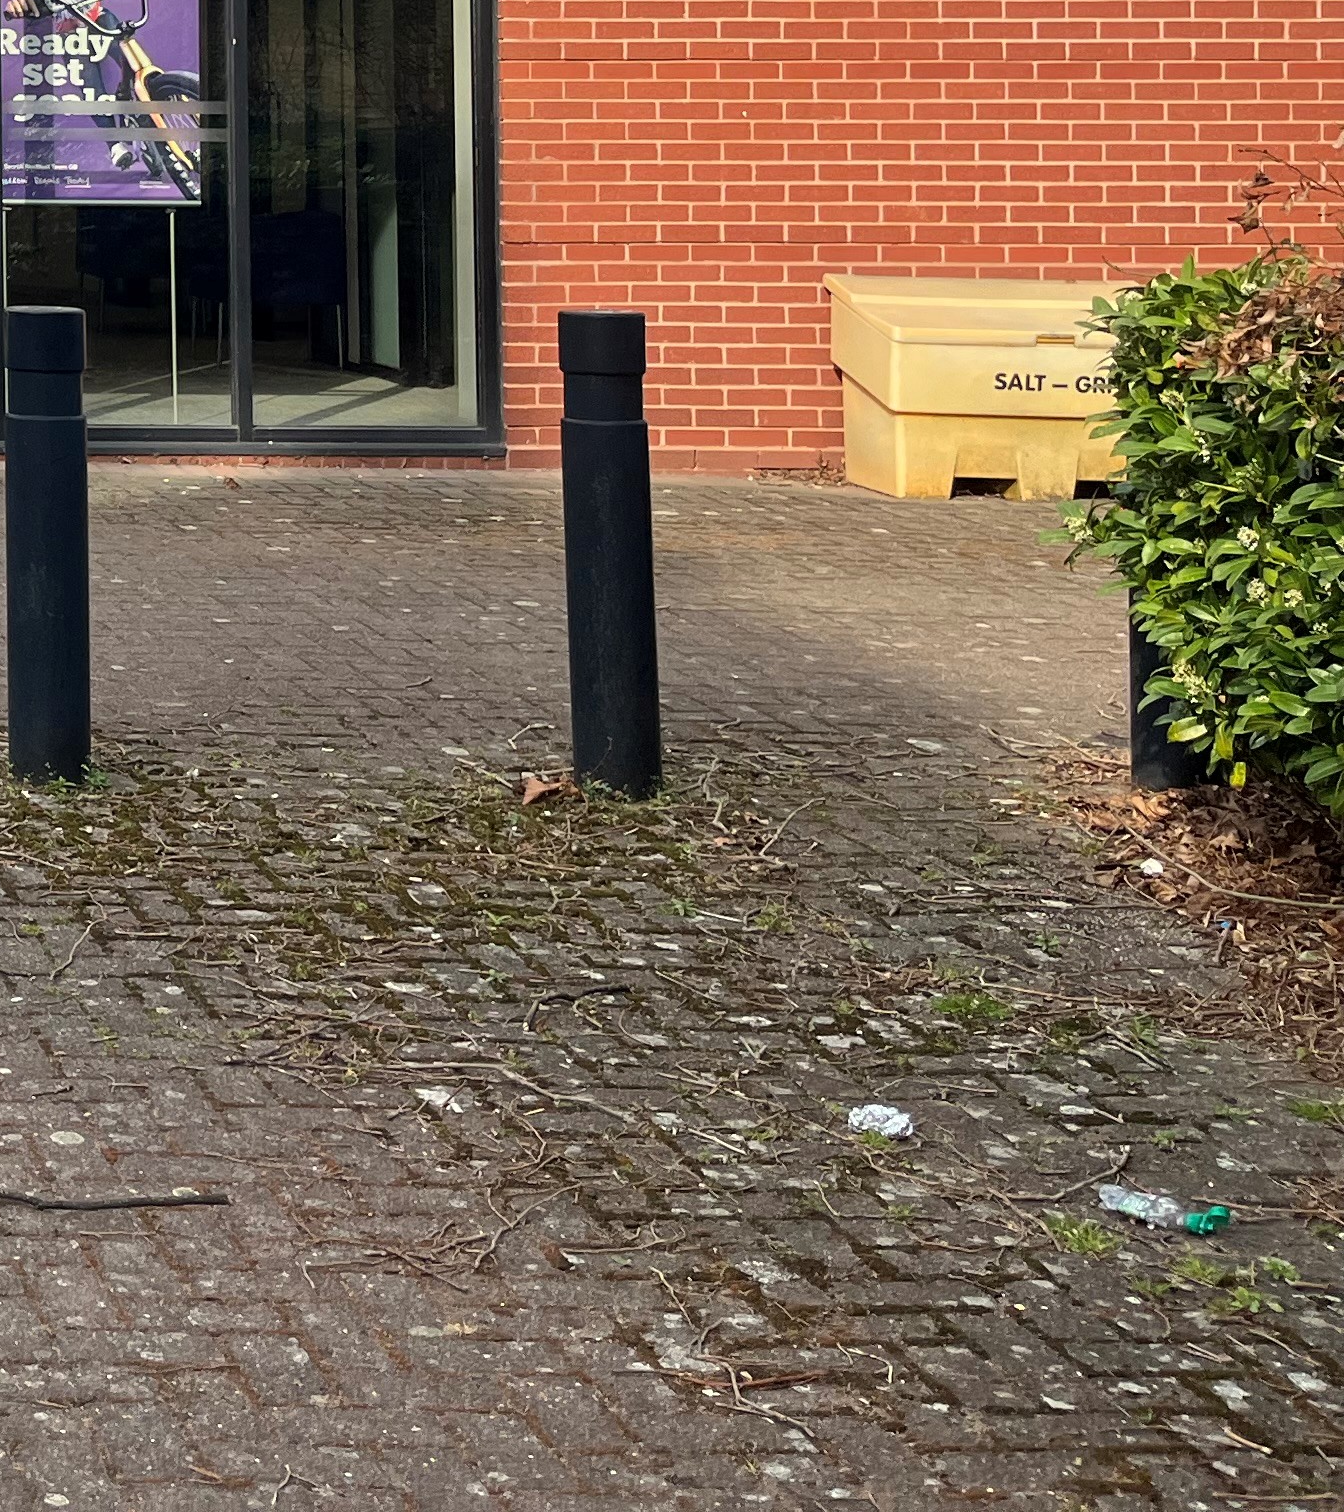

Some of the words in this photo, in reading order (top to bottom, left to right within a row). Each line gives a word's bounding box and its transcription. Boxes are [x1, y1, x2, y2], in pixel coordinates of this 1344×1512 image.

[0, 27, 114, 62] Ready
[22, 59, 85, 86] set
[994, 373, 1047, 392] SALT
[1075, 375, 1115, 394] GRI
